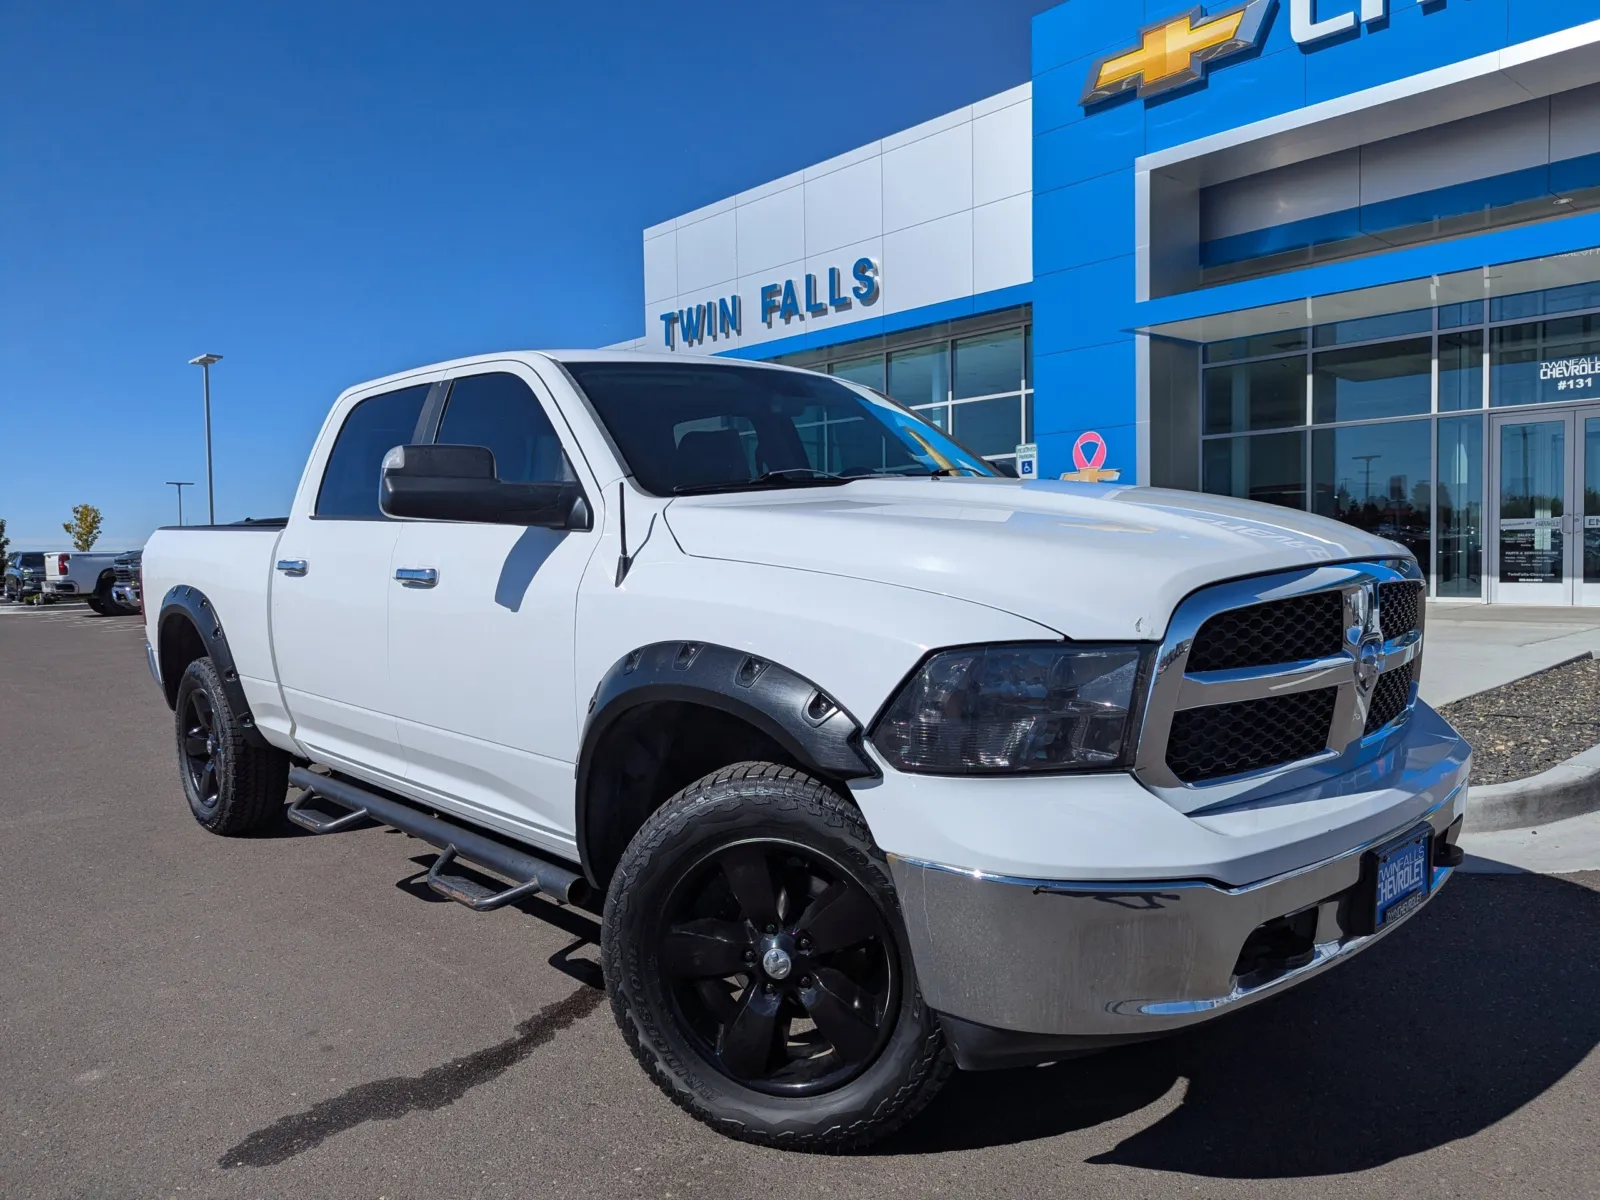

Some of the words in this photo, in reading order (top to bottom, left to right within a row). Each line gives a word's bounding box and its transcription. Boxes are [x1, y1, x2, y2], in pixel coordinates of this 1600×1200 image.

[660, 294, 741, 350] TWIN
[761, 257, 879, 327] FALLS
[1557, 377, 1592, 390] #131
